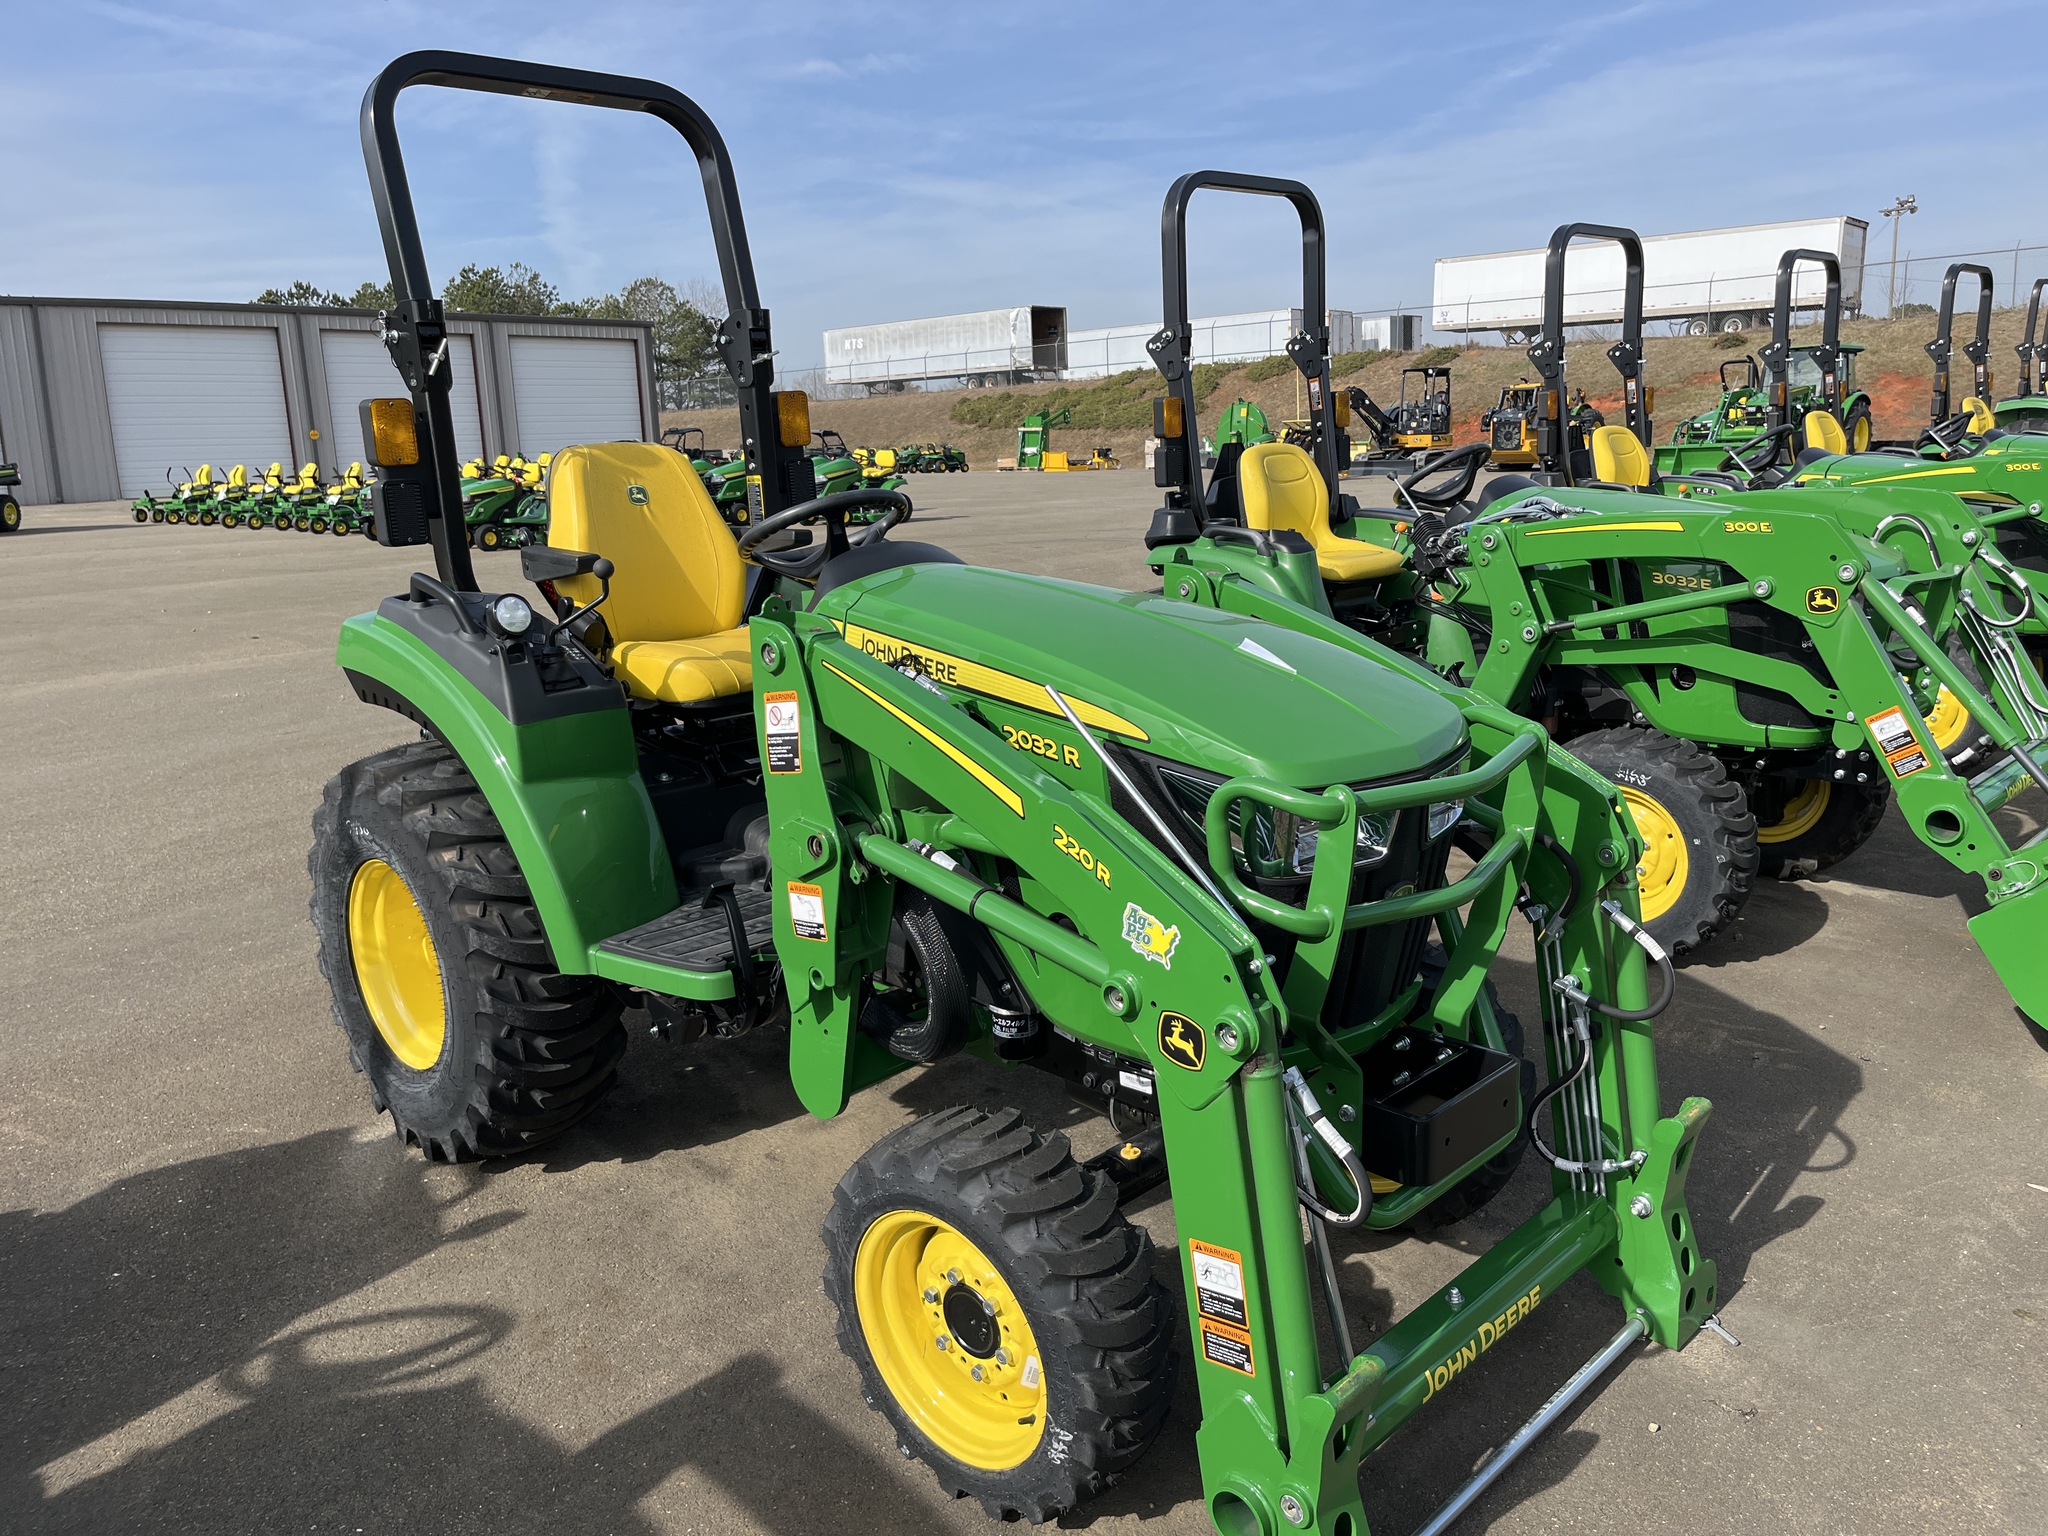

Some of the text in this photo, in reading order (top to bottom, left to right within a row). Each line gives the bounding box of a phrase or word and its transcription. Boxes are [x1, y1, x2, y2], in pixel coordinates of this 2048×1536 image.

[844, 338, 864, 350] KTS
[2005, 462, 2041, 472] 300 E
[1723, 521, 1773, 533] 300 E
[1652, 572, 1712, 590] 3032 E
[861, 633, 898, 663] JOHN
[770, 692, 796, 701] WARNING
[1002, 724, 1082, 770] 2032 R
[1052, 823, 1112, 891] 220 R
[794, 885, 820, 895] WARNING
[1127, 907, 1152, 930] Ag-
[1126, 922, 1151, 945] Pro
[1203, 1245, 1235, 1260] WARNING
[1213, 1325, 1246, 1342] WARNING
[1422, 1284, 1541, 1405] JOHN DEERE
